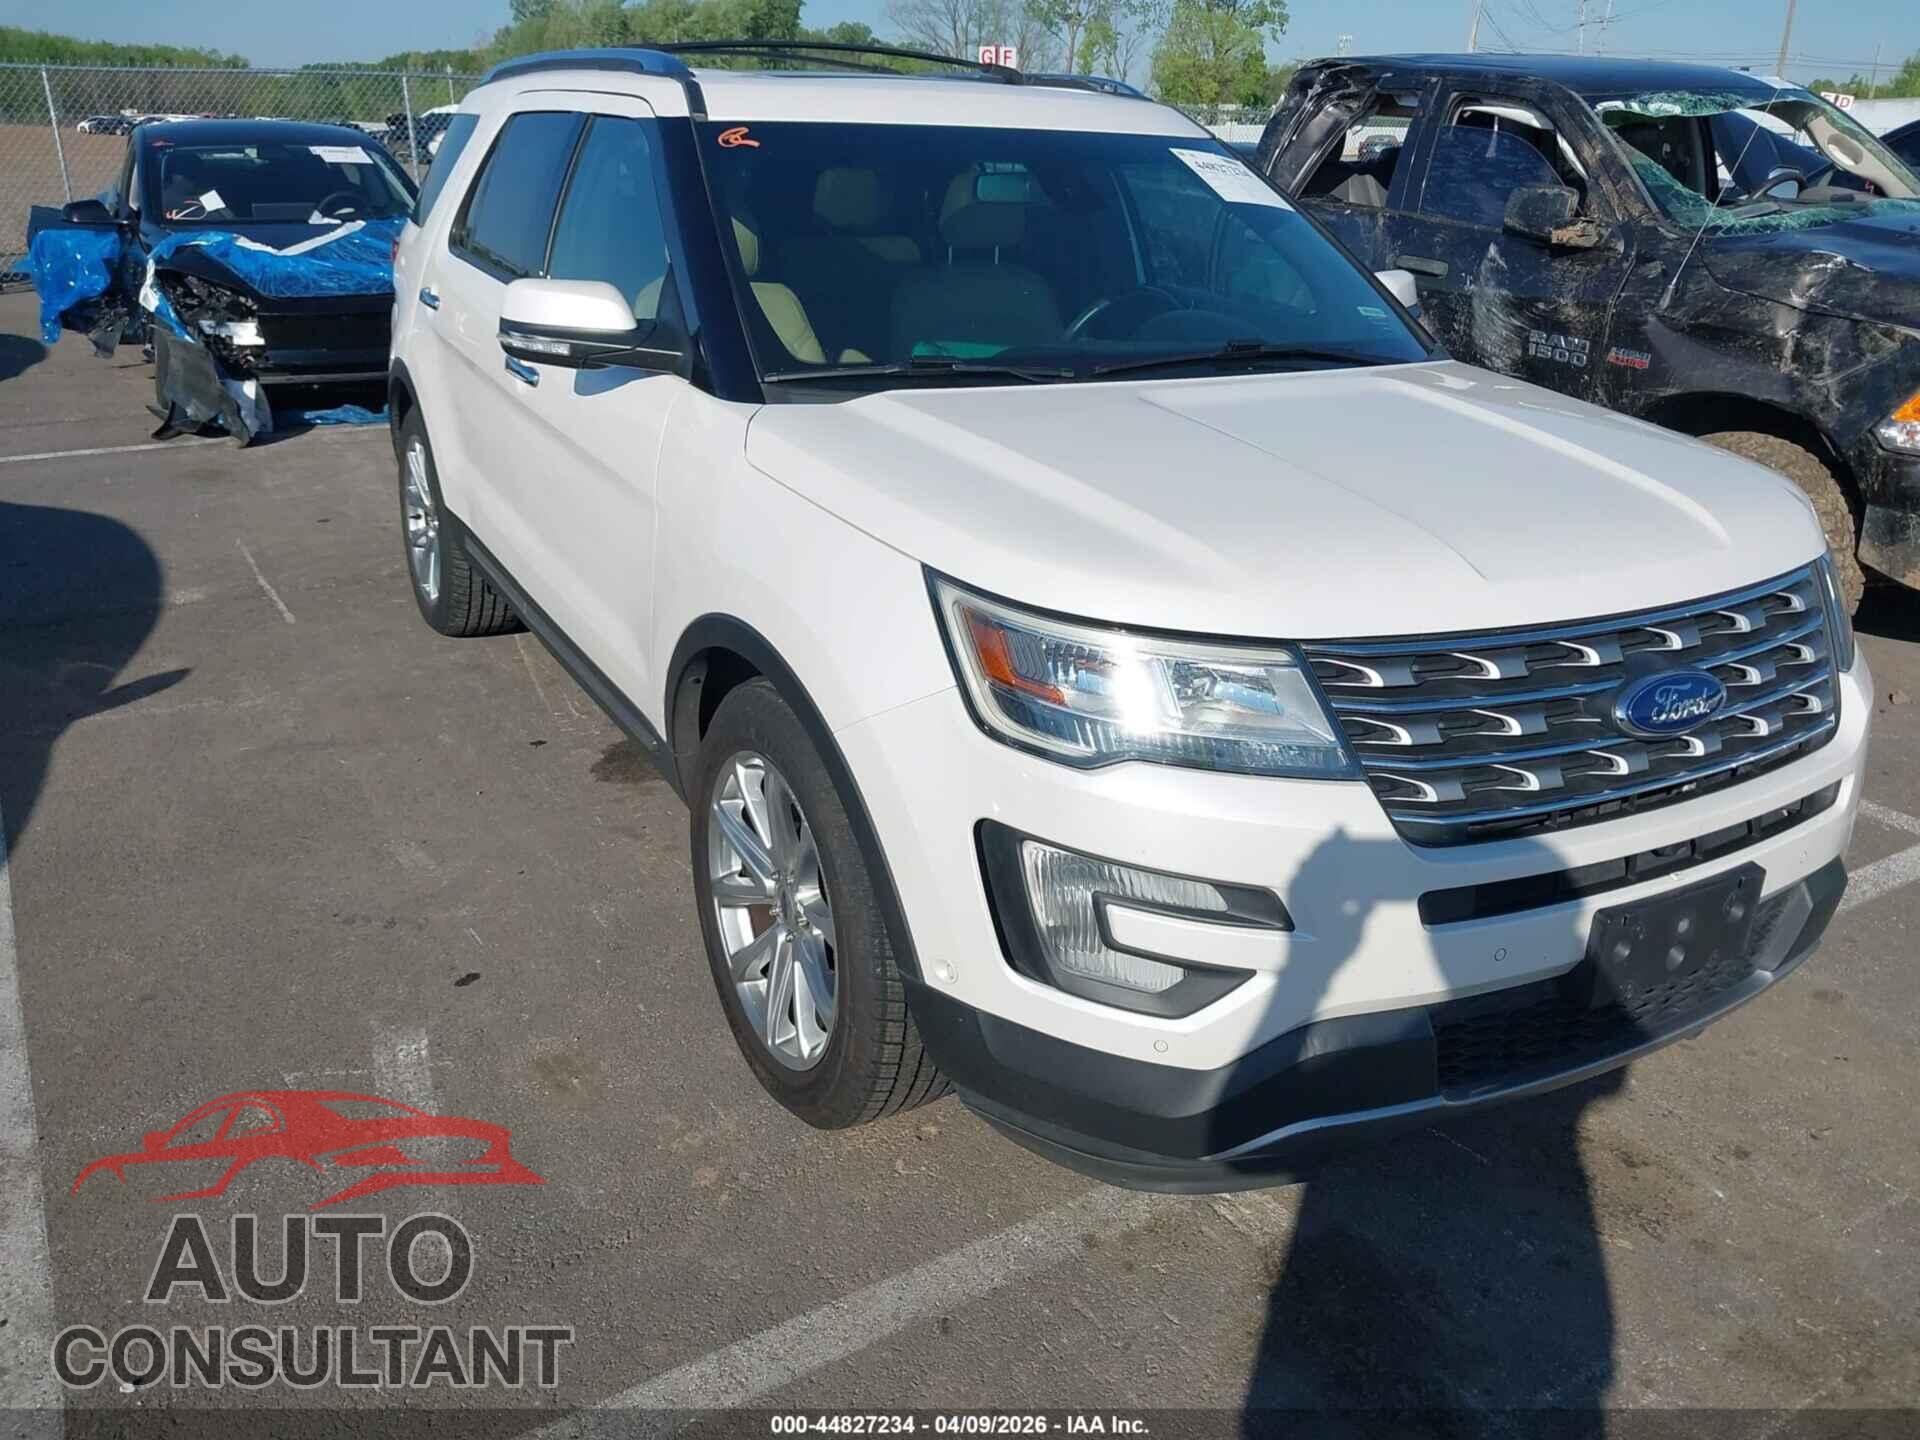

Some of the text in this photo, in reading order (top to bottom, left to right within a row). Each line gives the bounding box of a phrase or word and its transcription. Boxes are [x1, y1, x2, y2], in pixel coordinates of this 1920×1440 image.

[1003, 49, 1013, 65] F
[1528, 329, 1590, 353] RAM
[1528, 342, 1587, 367] 1500
[1648, 681, 1712, 724] Ford
